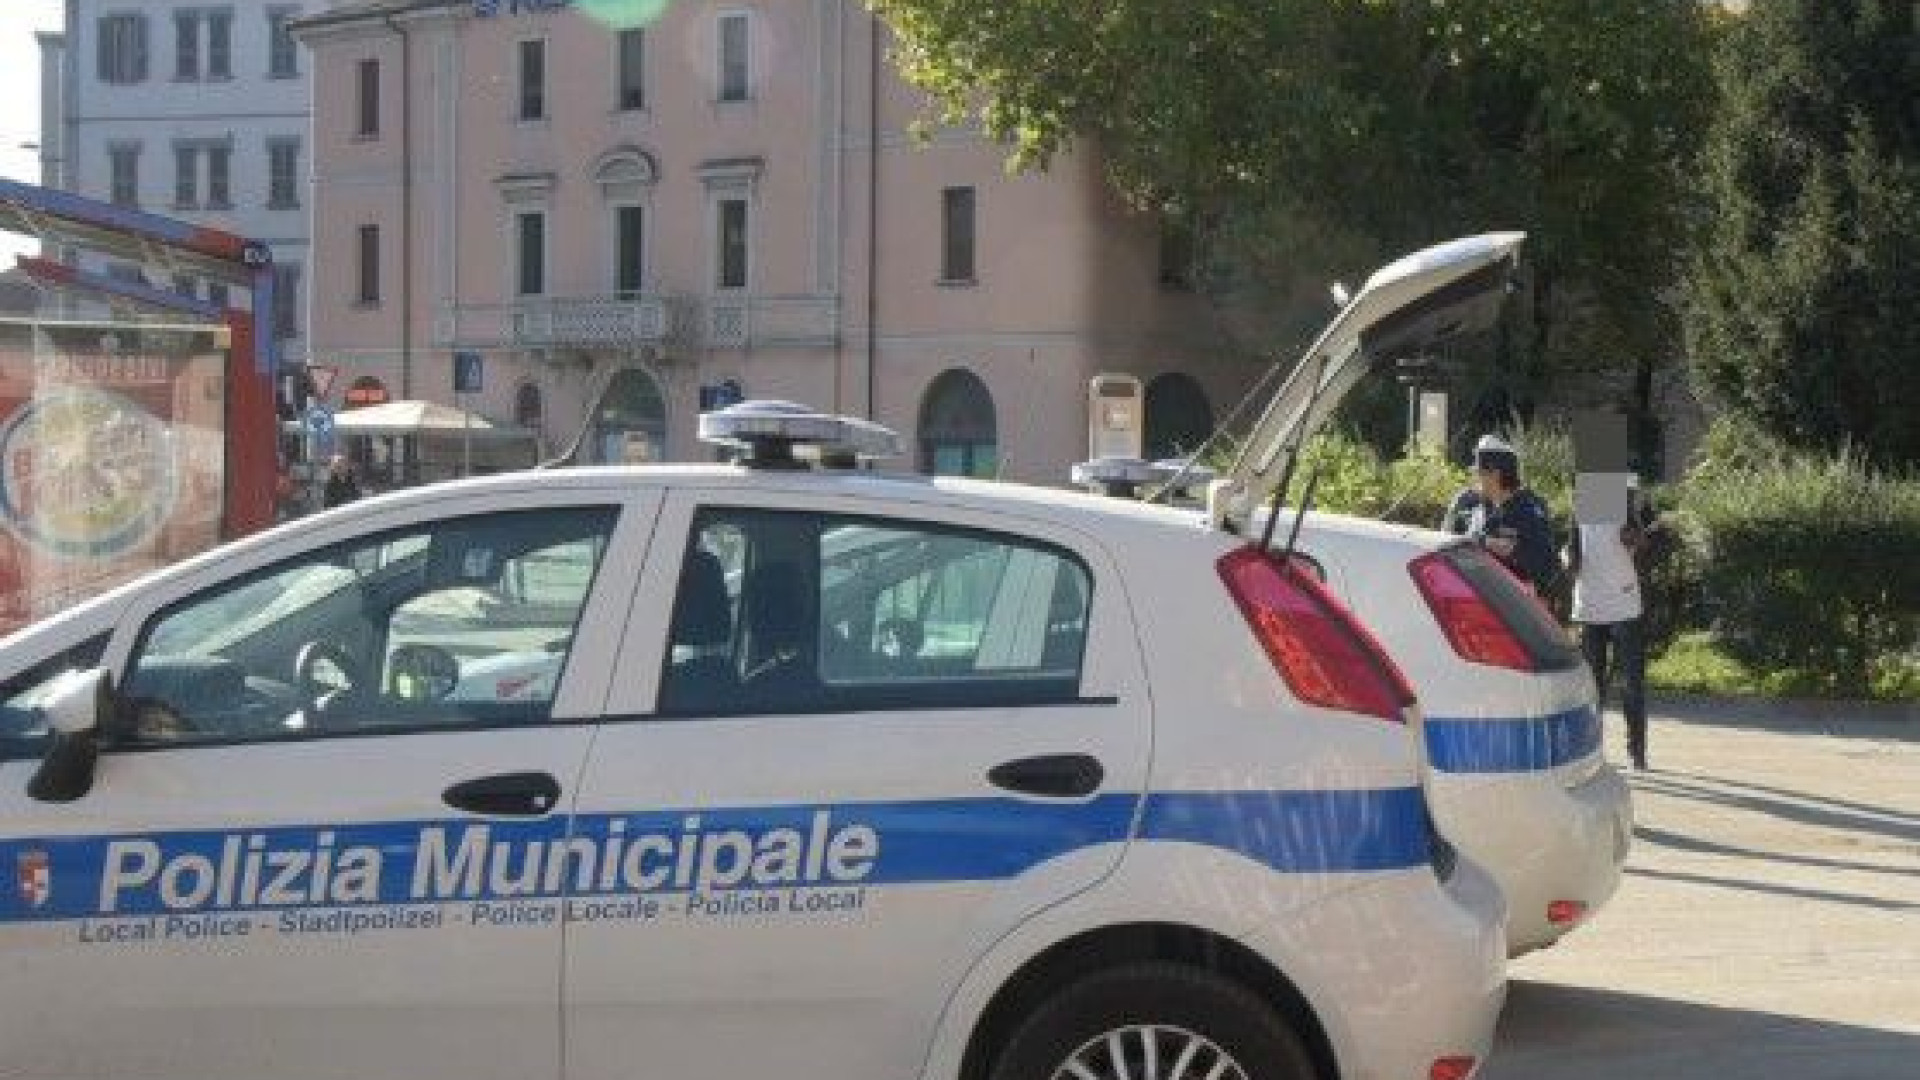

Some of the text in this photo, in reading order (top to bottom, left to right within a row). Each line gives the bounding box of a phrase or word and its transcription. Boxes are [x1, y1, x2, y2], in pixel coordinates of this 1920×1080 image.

[101, 810, 880, 912] Polizia Municipale
[79, 916, 156, 943] Local
[165, 914, 250, 940] Police
[278, 906, 444, 936] Stadtpolizei
[471, 901, 556, 926] Police
[566, 897, 658, 922] Locale
[788, 887, 865, 913] Local
